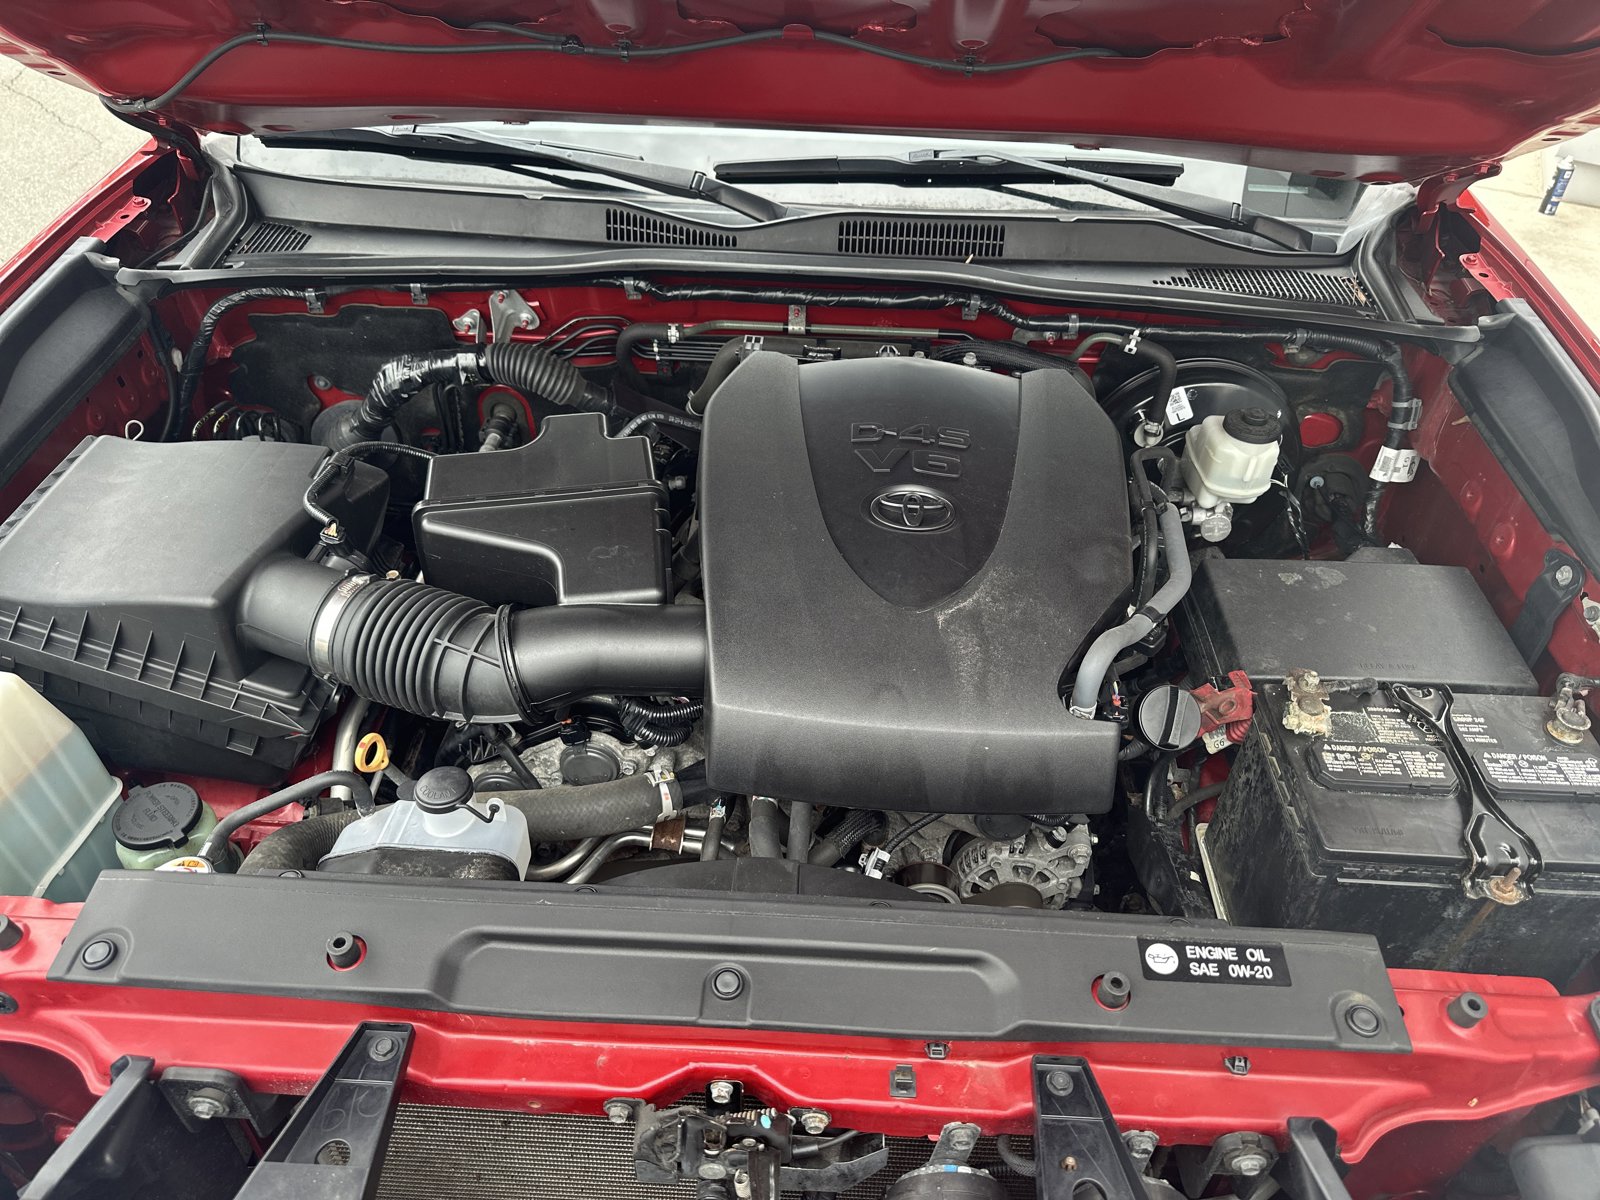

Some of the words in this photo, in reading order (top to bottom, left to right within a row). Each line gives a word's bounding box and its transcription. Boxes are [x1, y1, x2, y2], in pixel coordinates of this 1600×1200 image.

[851, 422, 971, 449] D-4S
[854, 448, 962, 477] V6
[1331, 744, 1358, 752] DANGER
[1362, 745, 1387, 754] POISON
[1490, 752, 1518, 760] DANGER
[420, 784, 457, 800] COOLANT
[1185, 945, 1239, 961] ENGINE
[1245, 948, 1271, 963] OIL
[1189, 961, 1220, 977] SAE
[1228, 964, 1273, 979] 0W-20
